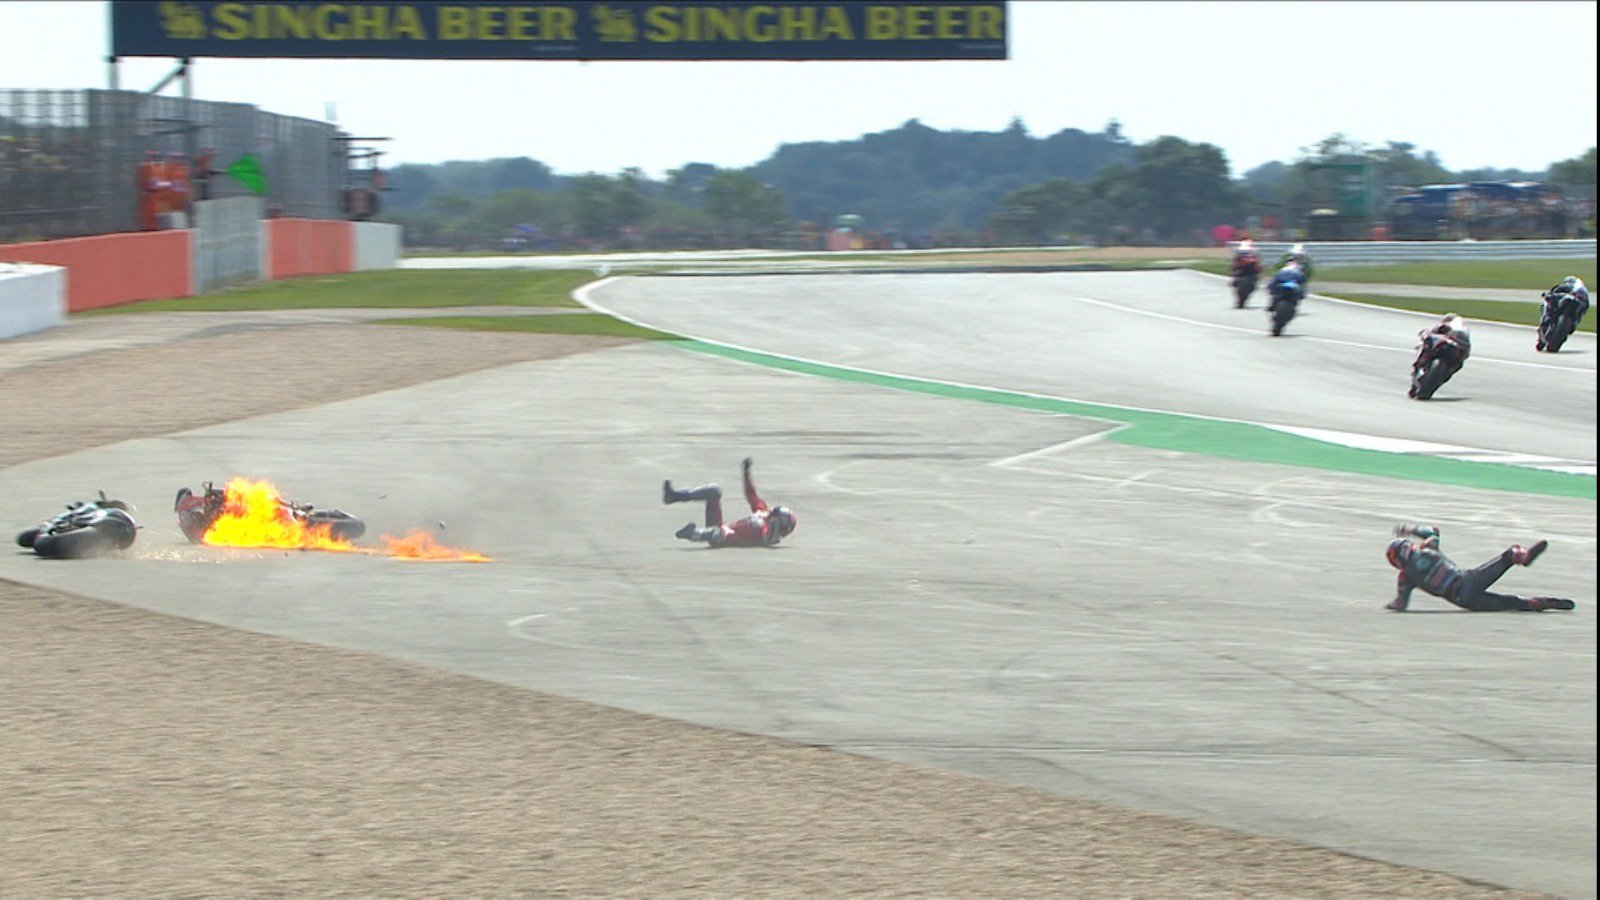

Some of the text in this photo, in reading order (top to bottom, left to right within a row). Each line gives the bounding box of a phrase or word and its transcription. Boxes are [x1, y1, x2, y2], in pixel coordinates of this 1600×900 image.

[211, 3, 577, 41] SINGHA BEER
[645, 5, 1004, 42] SINGHA BEER
